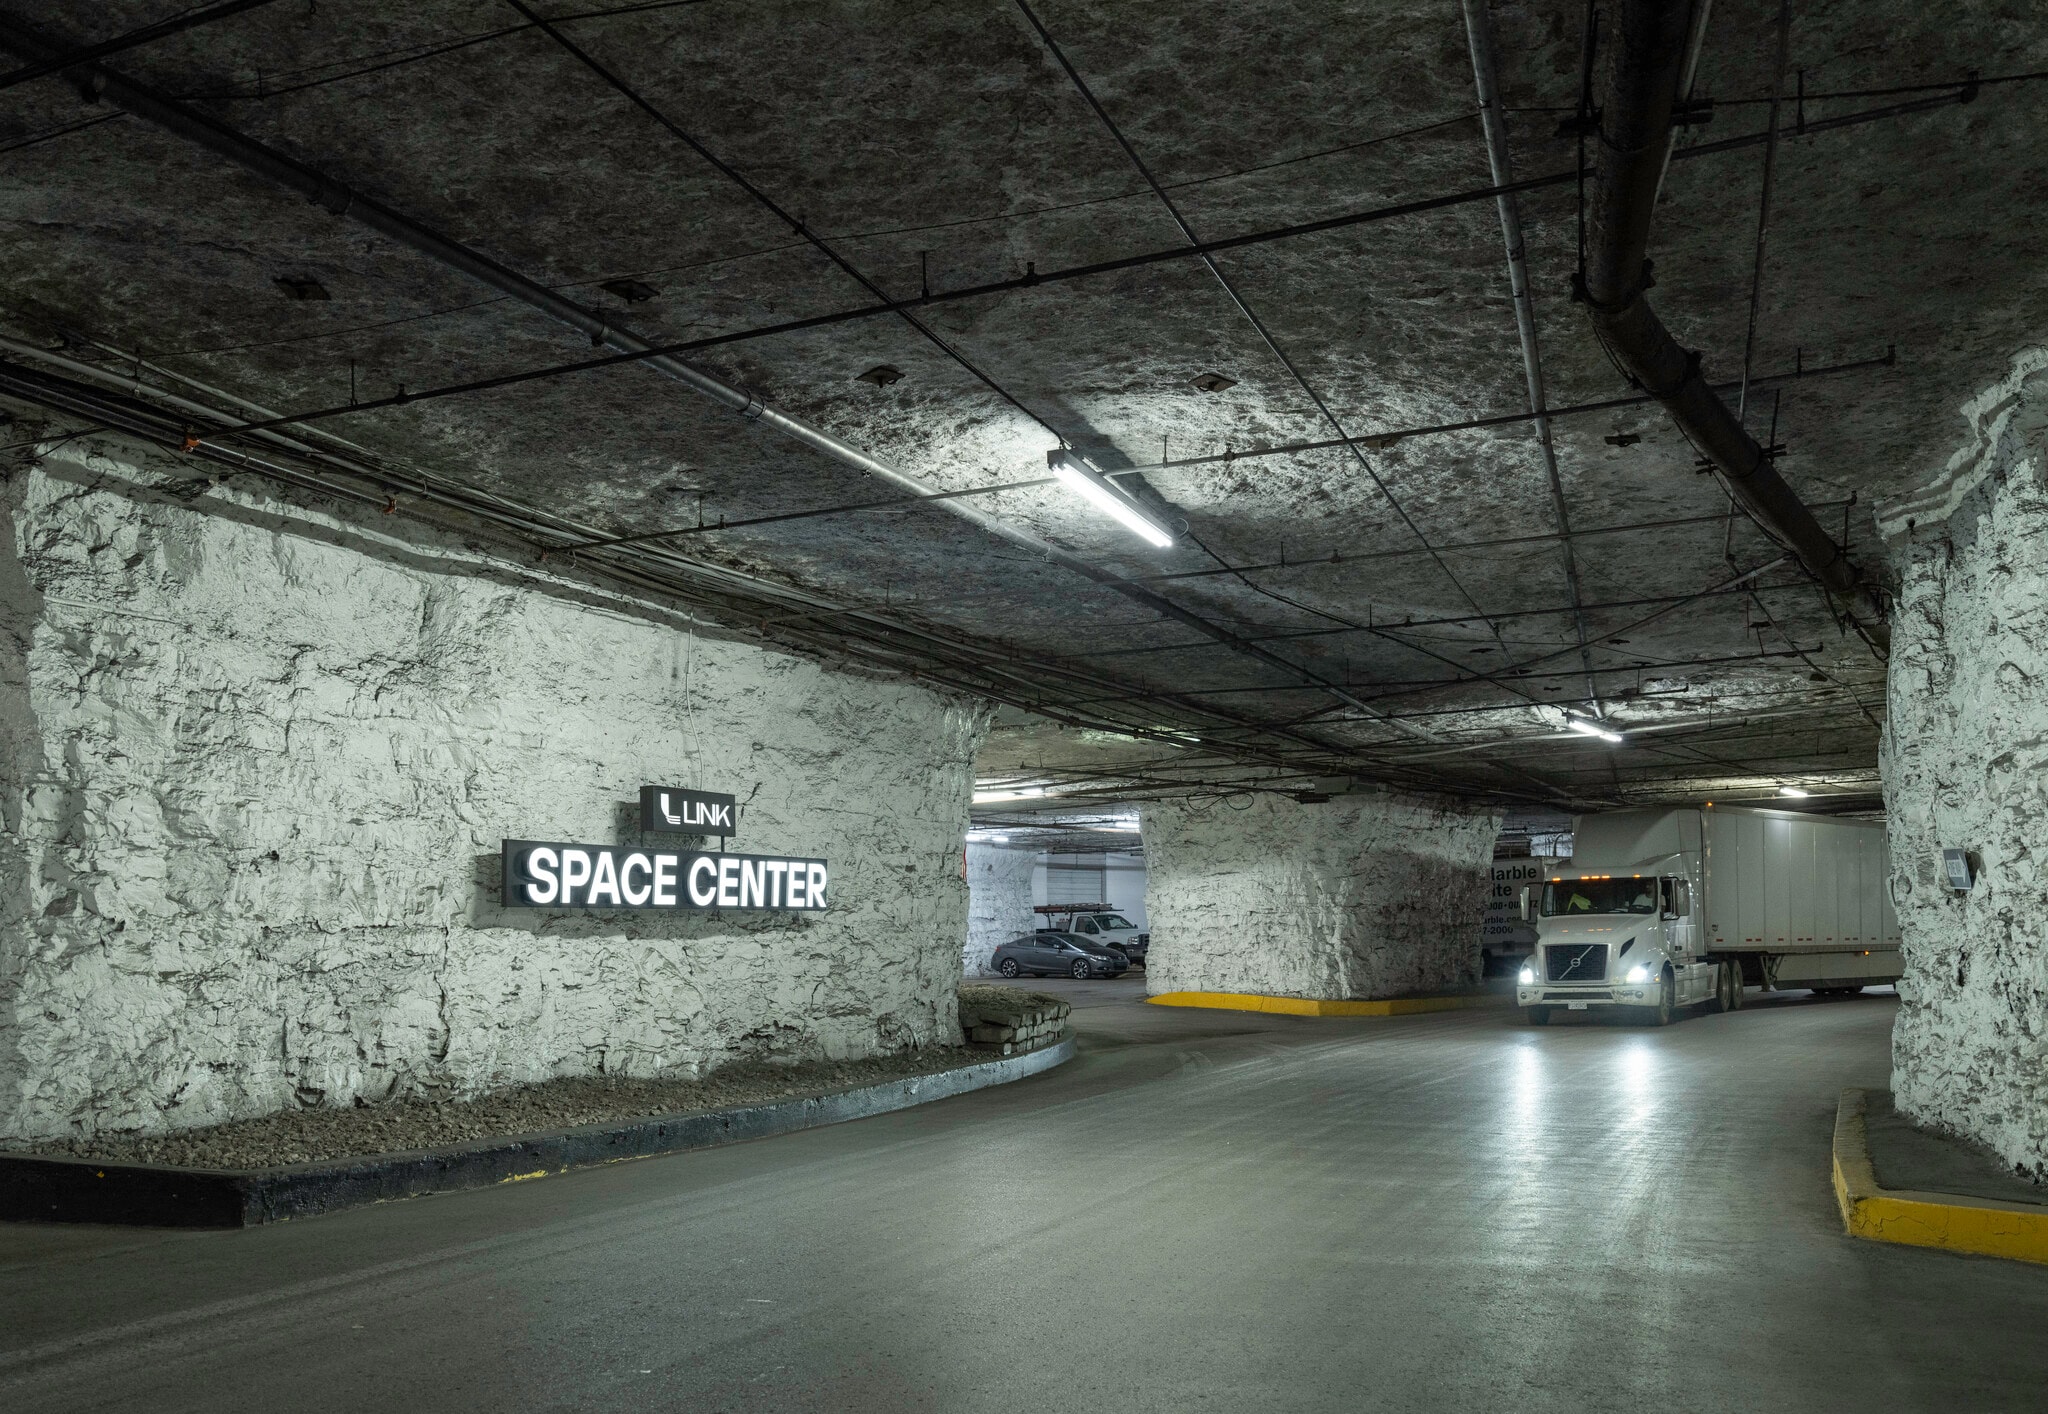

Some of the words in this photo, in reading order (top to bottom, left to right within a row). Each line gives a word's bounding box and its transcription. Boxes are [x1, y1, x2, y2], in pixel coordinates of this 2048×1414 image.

[683, 800, 731, 827] LINK
[527, 847, 678, 906] SPACE
[687, 856, 827, 908] CENTER
[1492, 883, 1512, 897] ite
[1483, 926, 1513, 935] 7-2000
